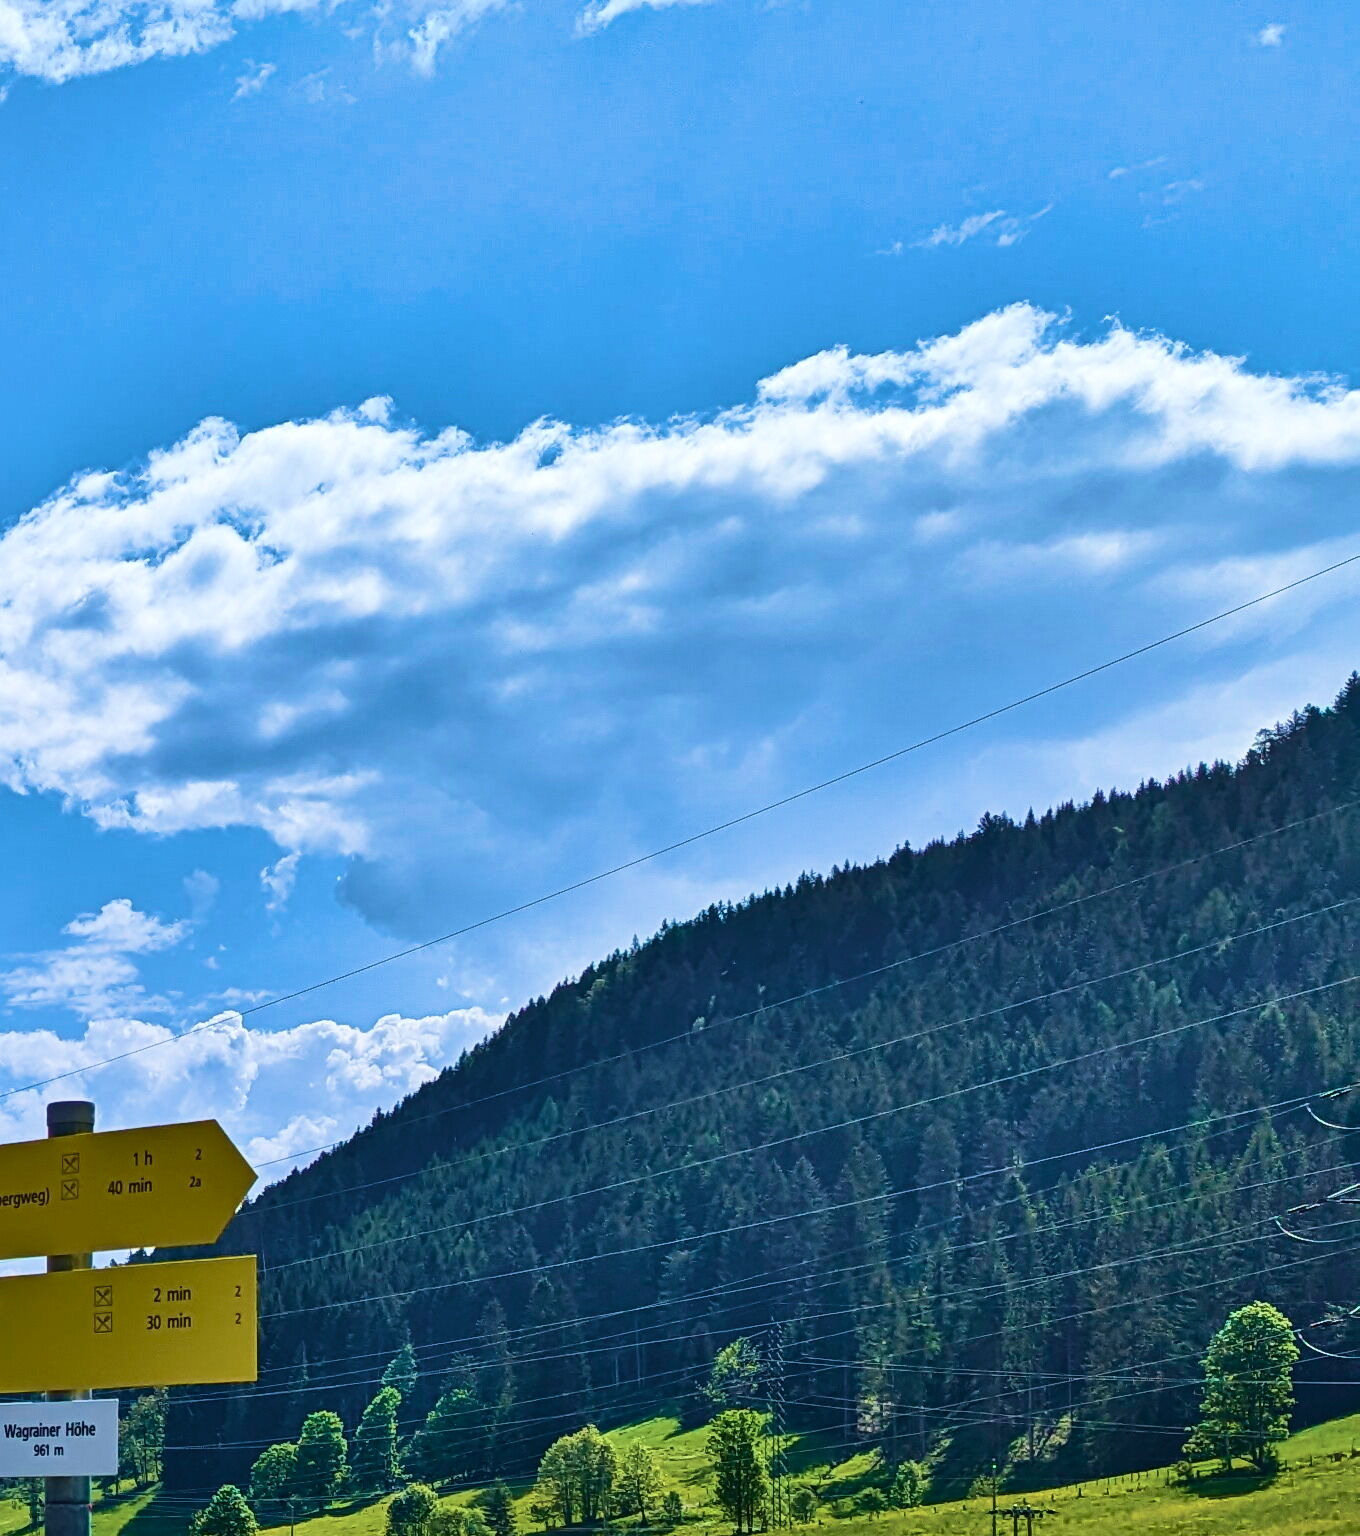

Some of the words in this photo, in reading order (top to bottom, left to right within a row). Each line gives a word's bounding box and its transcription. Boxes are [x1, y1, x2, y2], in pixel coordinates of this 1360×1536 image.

[133, 1153, 139, 1166] 1
[144, 1150, 153, 1166] h
[195, 1149, 202, 1161] 2
[108, 1180, 123, 1195] 40
[129, 1177, 153, 1193] min
[189, 1176, 202, 1188] 2a
[153, 1288, 161, 1302] 2
[167, 1286, 191, 1301] min
[235, 1286, 241, 1297] 2
[146, 1315, 161, 1330] 30
[167, 1313, 191, 1329] min
[235, 1313, 241, 1325] 2
[3, 1422, 61, 1442] Wagrainer
[65, 1421, 96, 1437] Höhe
[33, 1444, 50, 1457] 961
[54, 1446, 64, 1456] m
